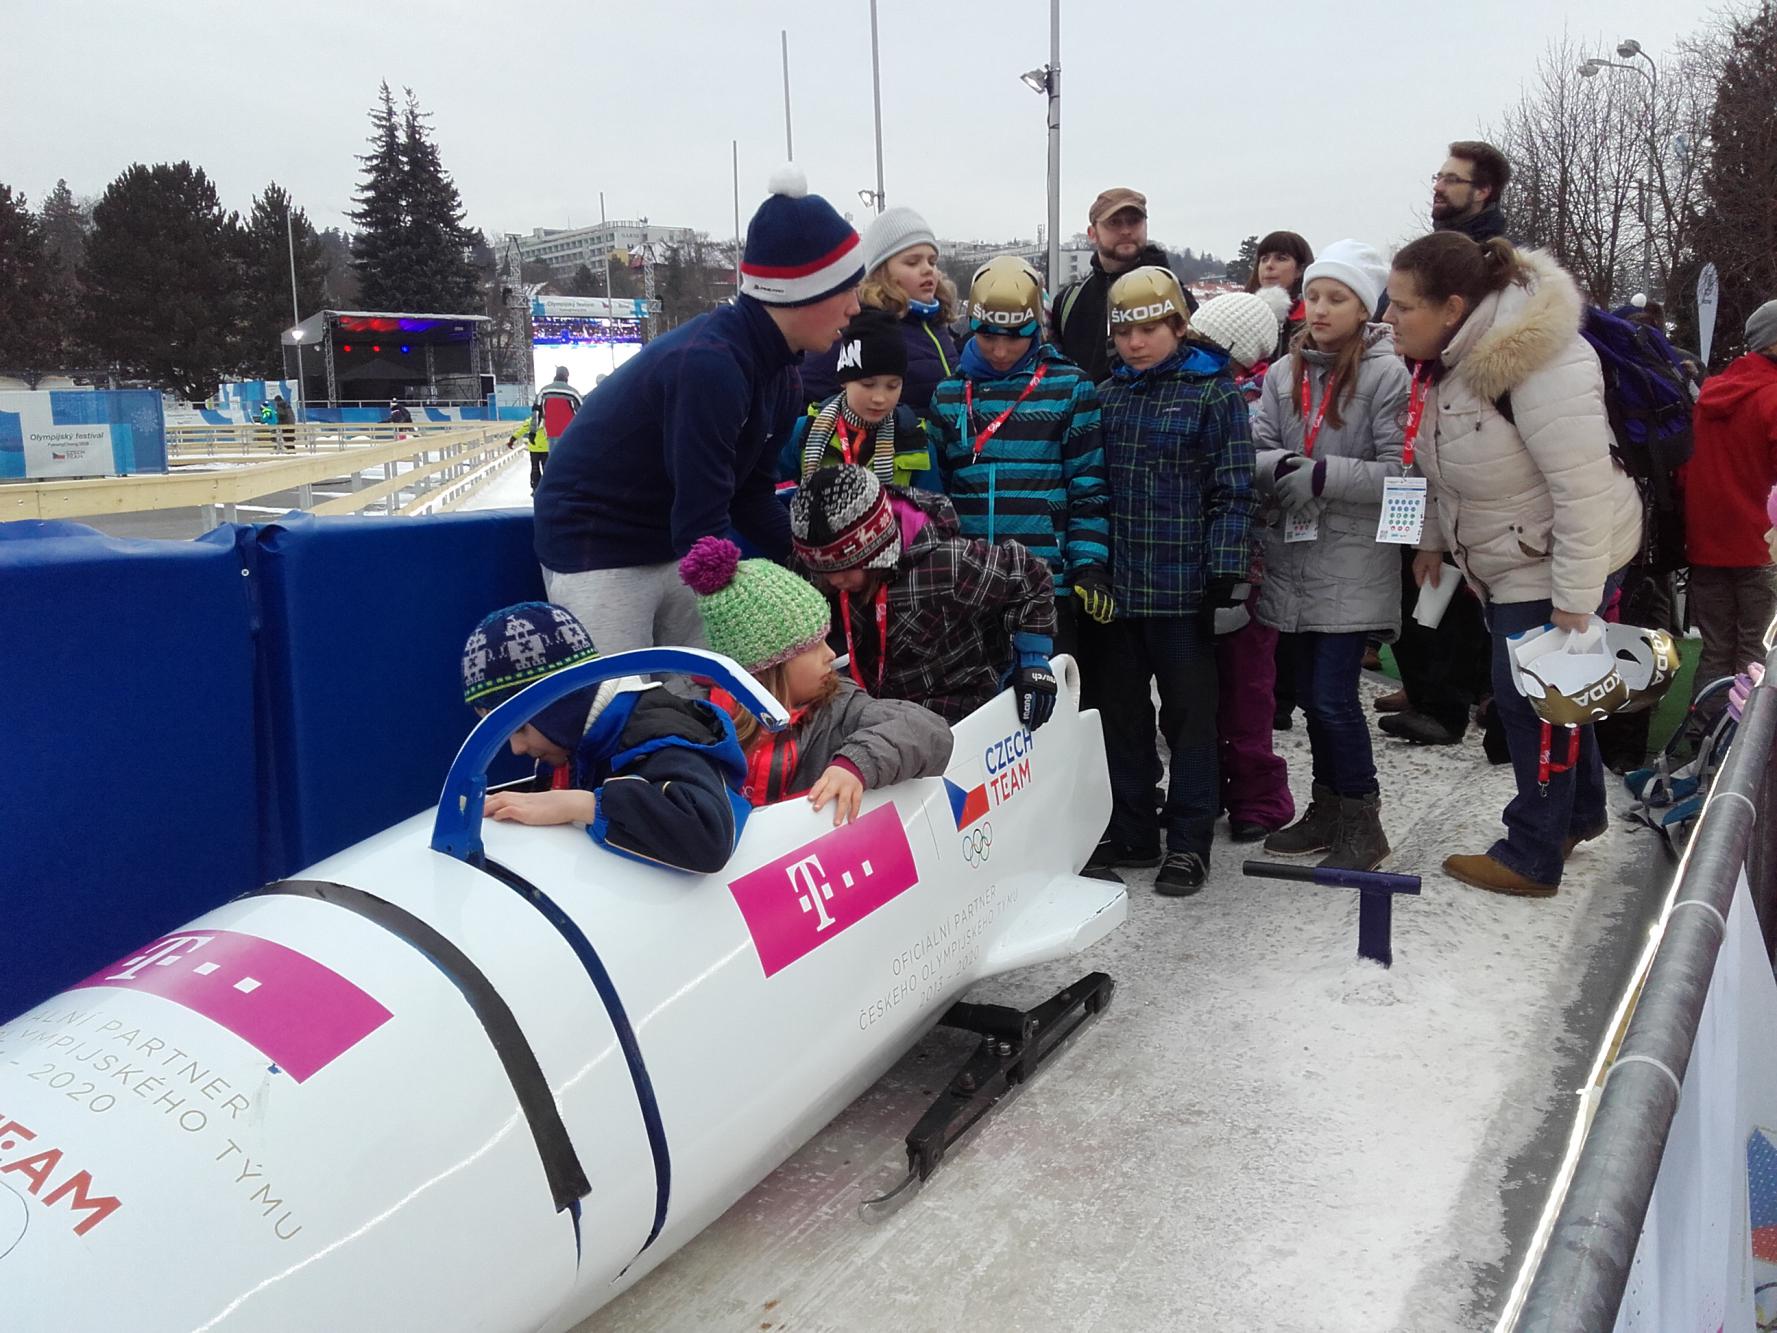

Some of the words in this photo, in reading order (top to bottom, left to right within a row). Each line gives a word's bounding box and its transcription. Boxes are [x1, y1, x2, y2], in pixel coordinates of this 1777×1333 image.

[973, 303, 1034, 324] ŠKODA
[1111, 298, 1175, 323] ŠKODA
[75, 432, 104, 440] festival
[985, 728, 1033, 775] CZECH
[990, 758, 1031, 806] TEAM
[954, 884, 996, 928] PARTNER
[27, 1063, 116, 1113] 2020
[95, 1019, 250, 1119] PARTNER
[0, 1113, 123, 1237] EAM
[216, 1138, 302, 1240] TÝMU
